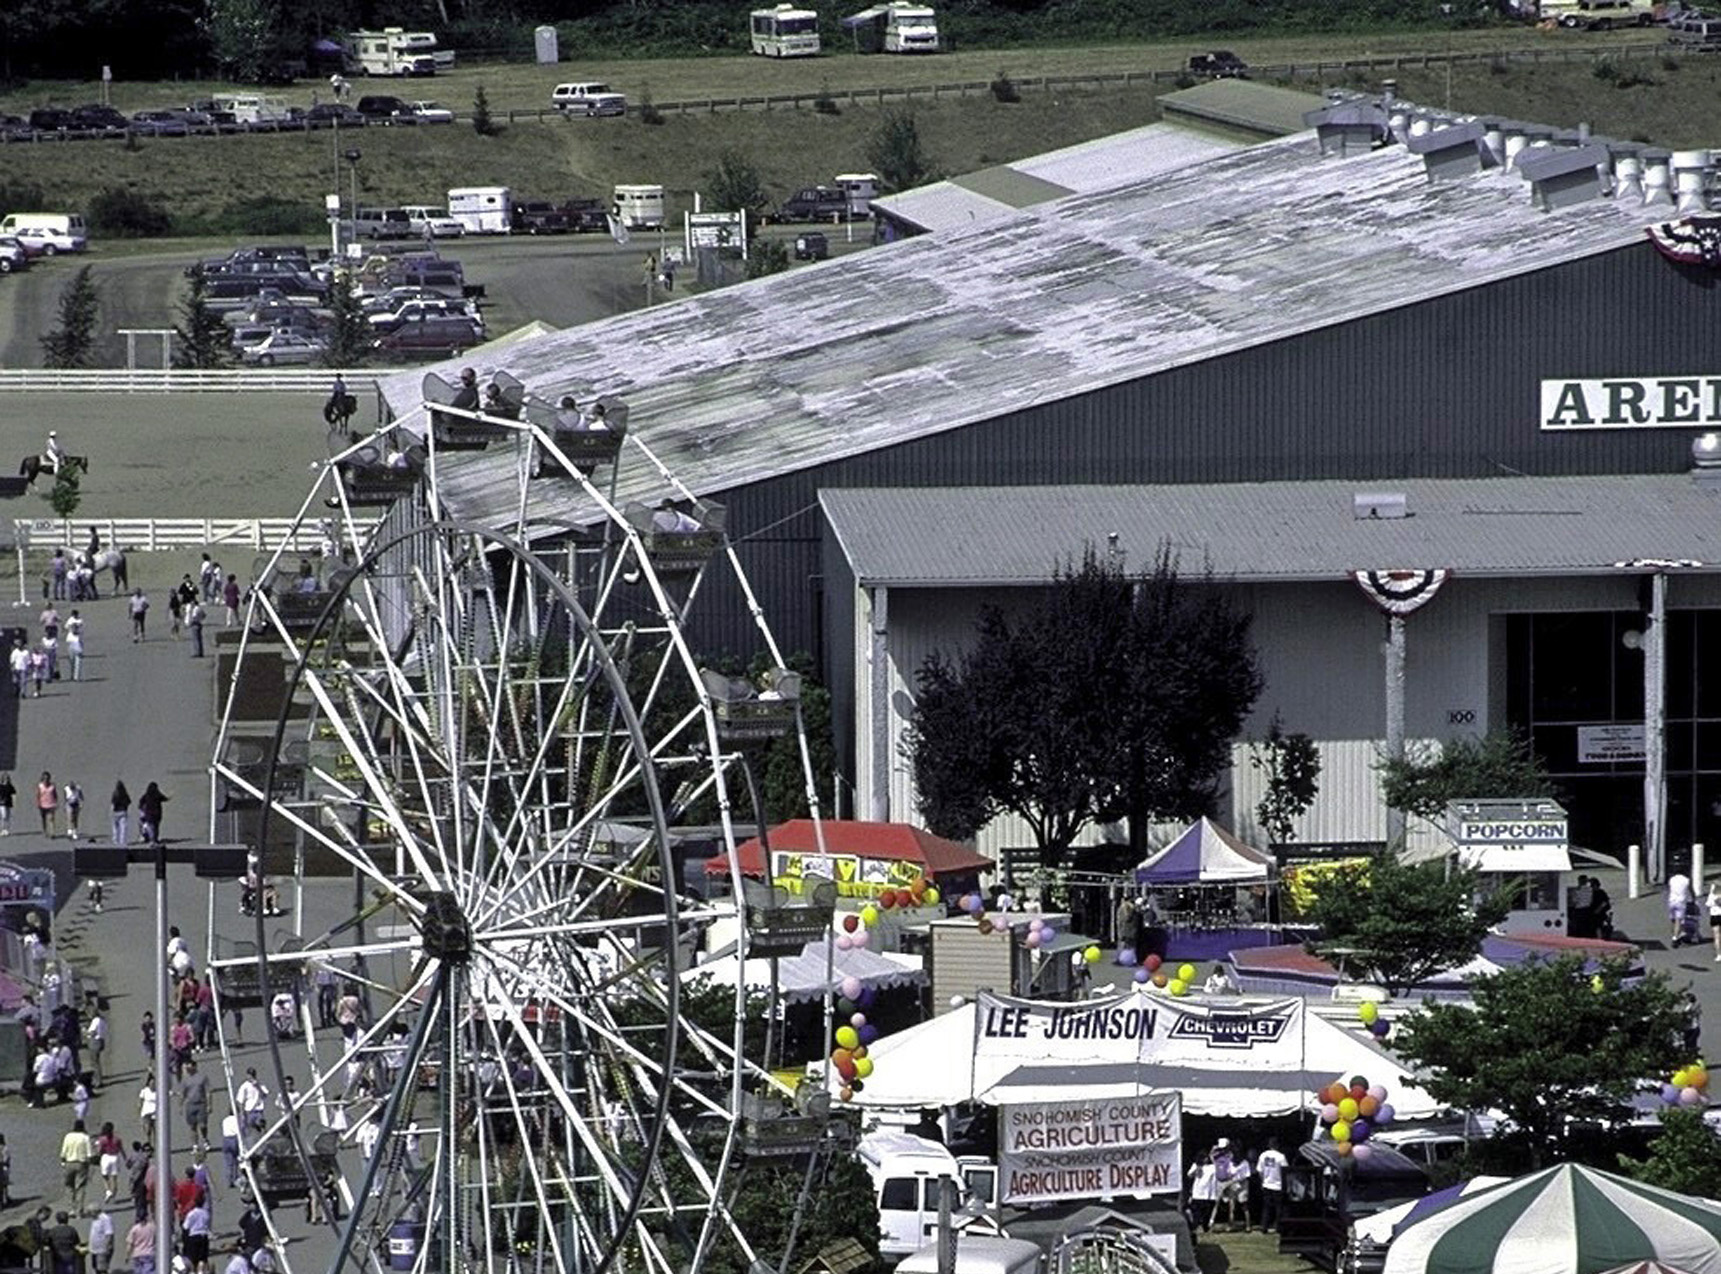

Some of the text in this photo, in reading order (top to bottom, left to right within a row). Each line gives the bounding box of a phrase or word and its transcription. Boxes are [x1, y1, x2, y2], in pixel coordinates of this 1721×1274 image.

[1466, 823, 1565, 839] POPCORN
[985, 1006, 1158, 1040] LEE JOHNSON
[1184, 1018, 1277, 1035] CHEVROLET
[1012, 1102, 1169, 1126] SNOHOMISH COUNTY
[1014, 1119, 1171, 1149] AGRICULTURE
[1024, 1147, 1156, 1168] SNOHOMISH COUNTY
[1010, 1168, 1104, 1196] AGRICULTURE
